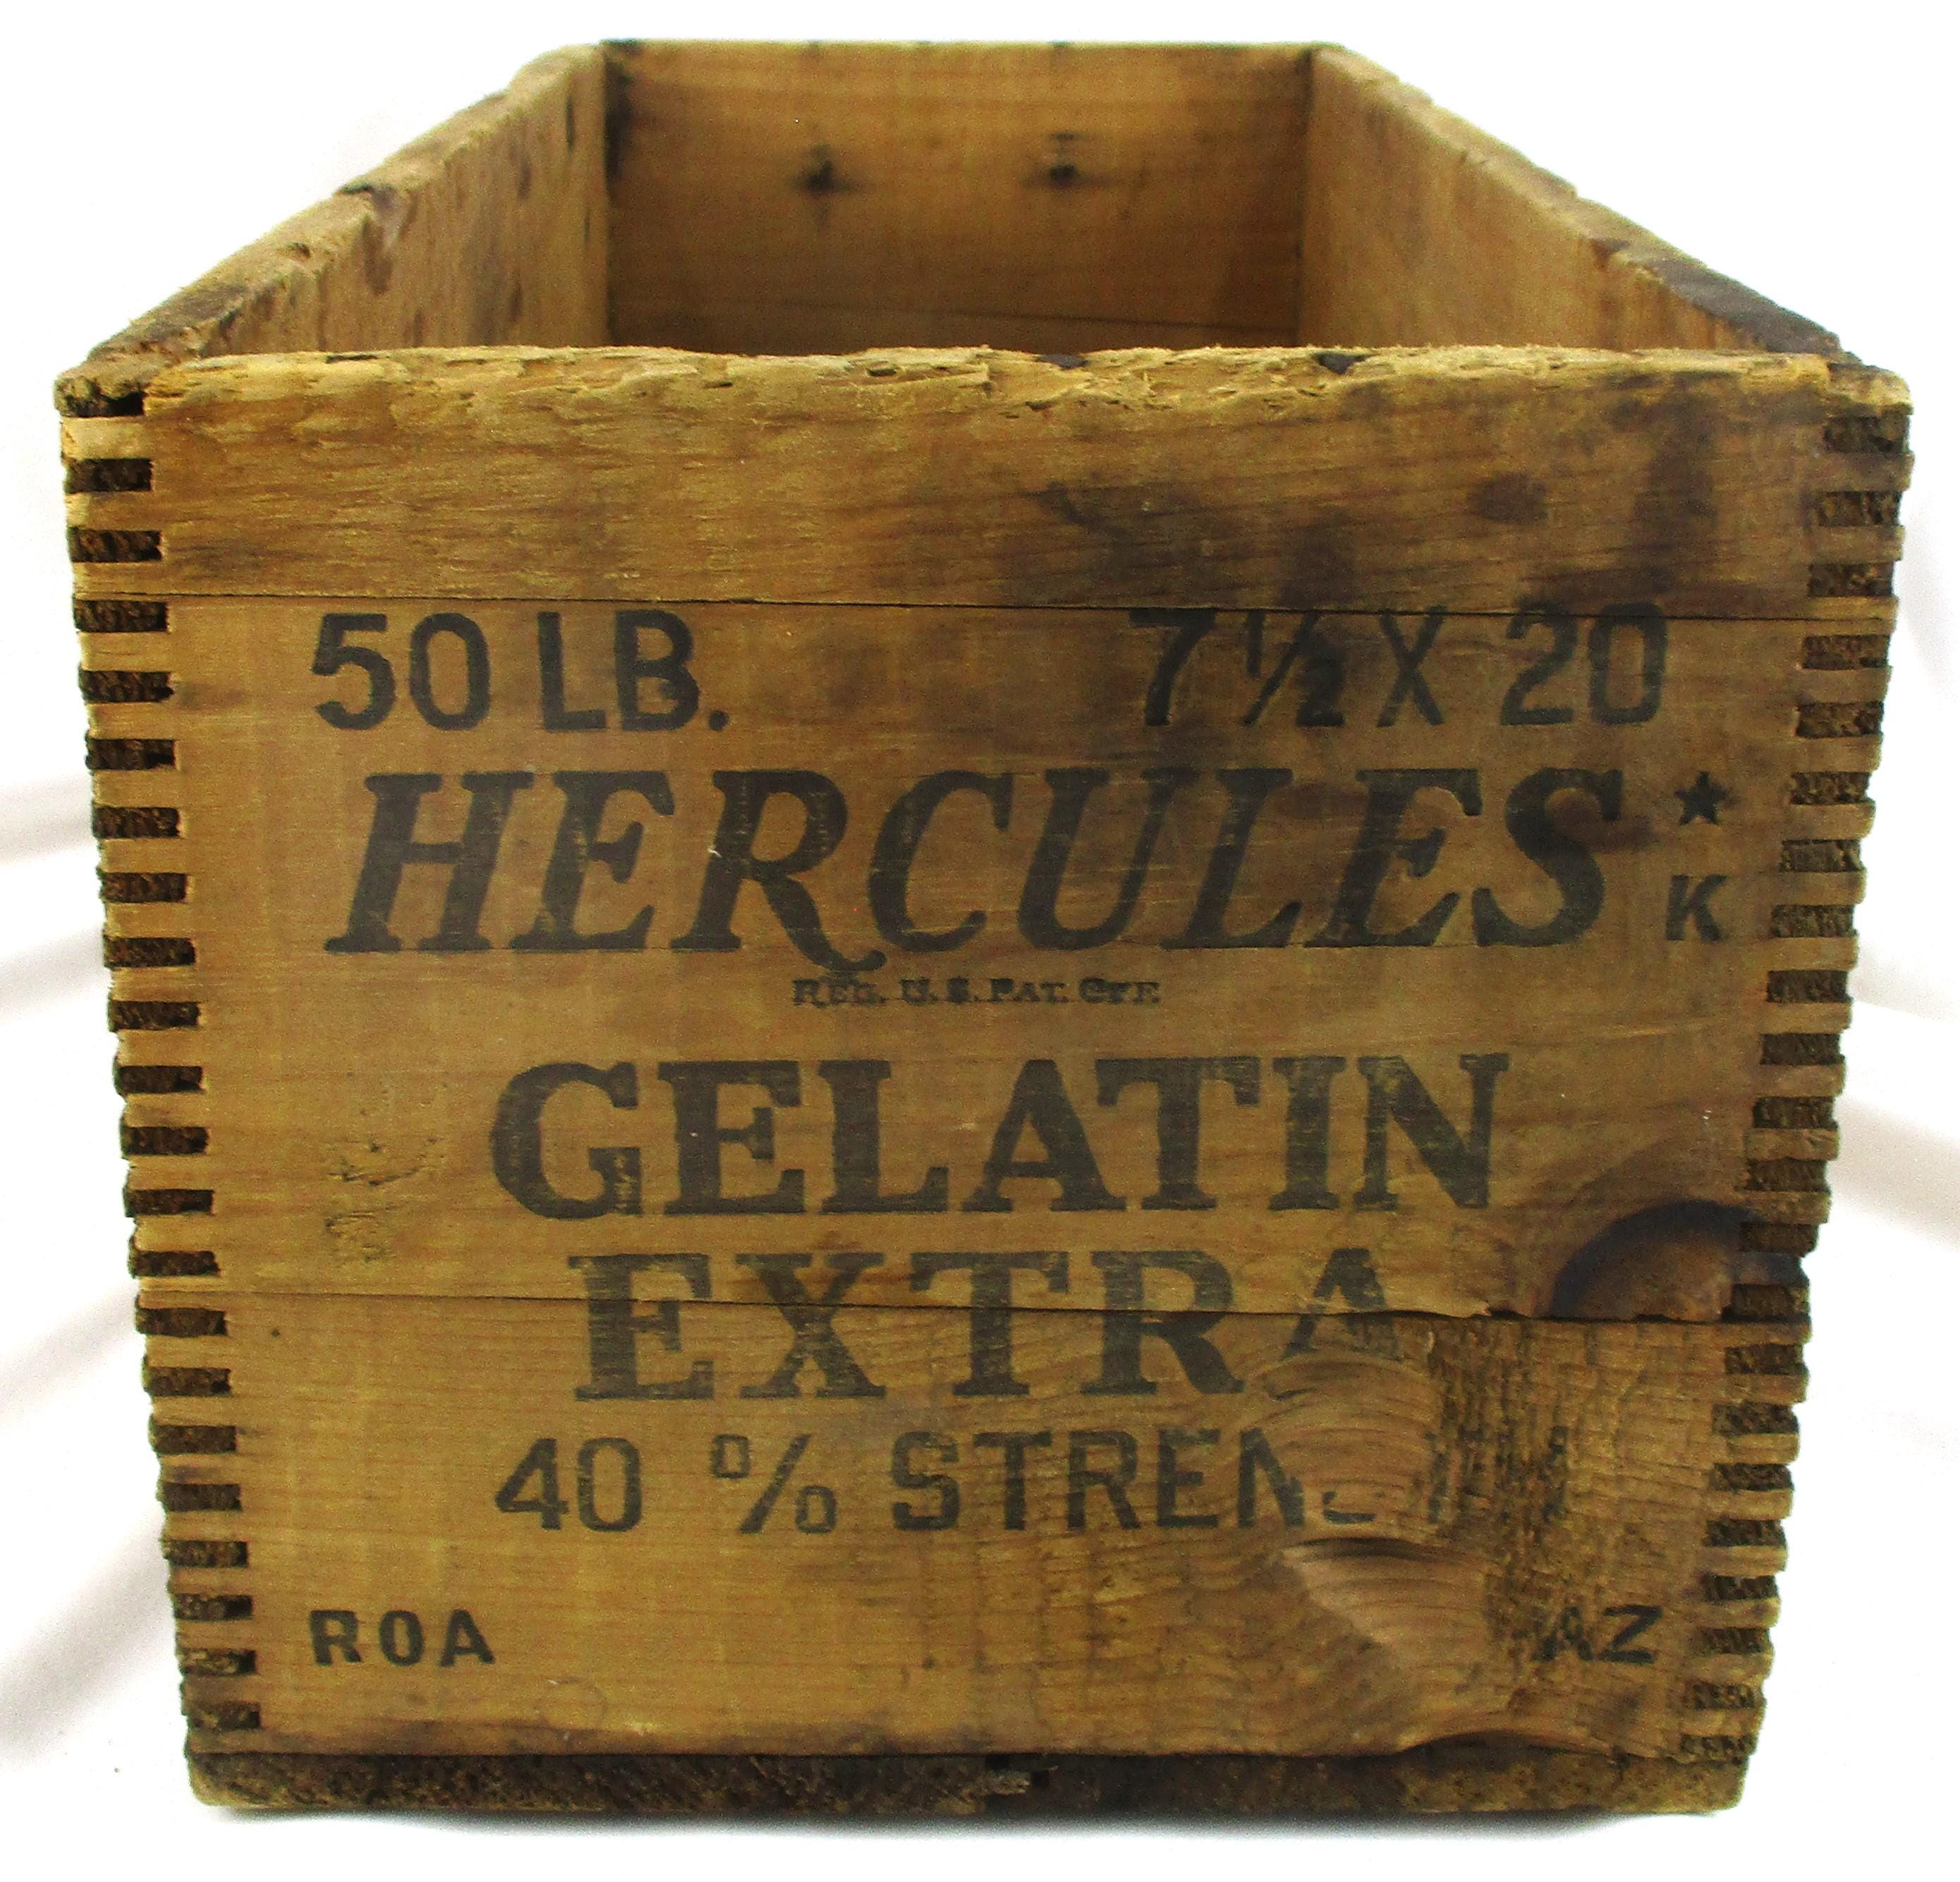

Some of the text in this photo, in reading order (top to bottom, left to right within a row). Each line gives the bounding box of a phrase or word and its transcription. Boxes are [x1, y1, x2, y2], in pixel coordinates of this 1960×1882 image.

[312, 610, 730, 731] 50 LB.
[1377, 605, 1447, 727] X
[1499, 600, 1667, 726] 20
[324, 767, 1624, 971] HERCULES
[1666, 875, 1727, 942] K
[490, 1053, 1510, 1220] GELATIN
[568, 1248, 1404, 1401] EXTRA
[495, 1426, 1569, 1534] 40 % STREN
[309, 1609, 494, 1667] ROA
[1532, 1605, 1663, 1664] AZ
